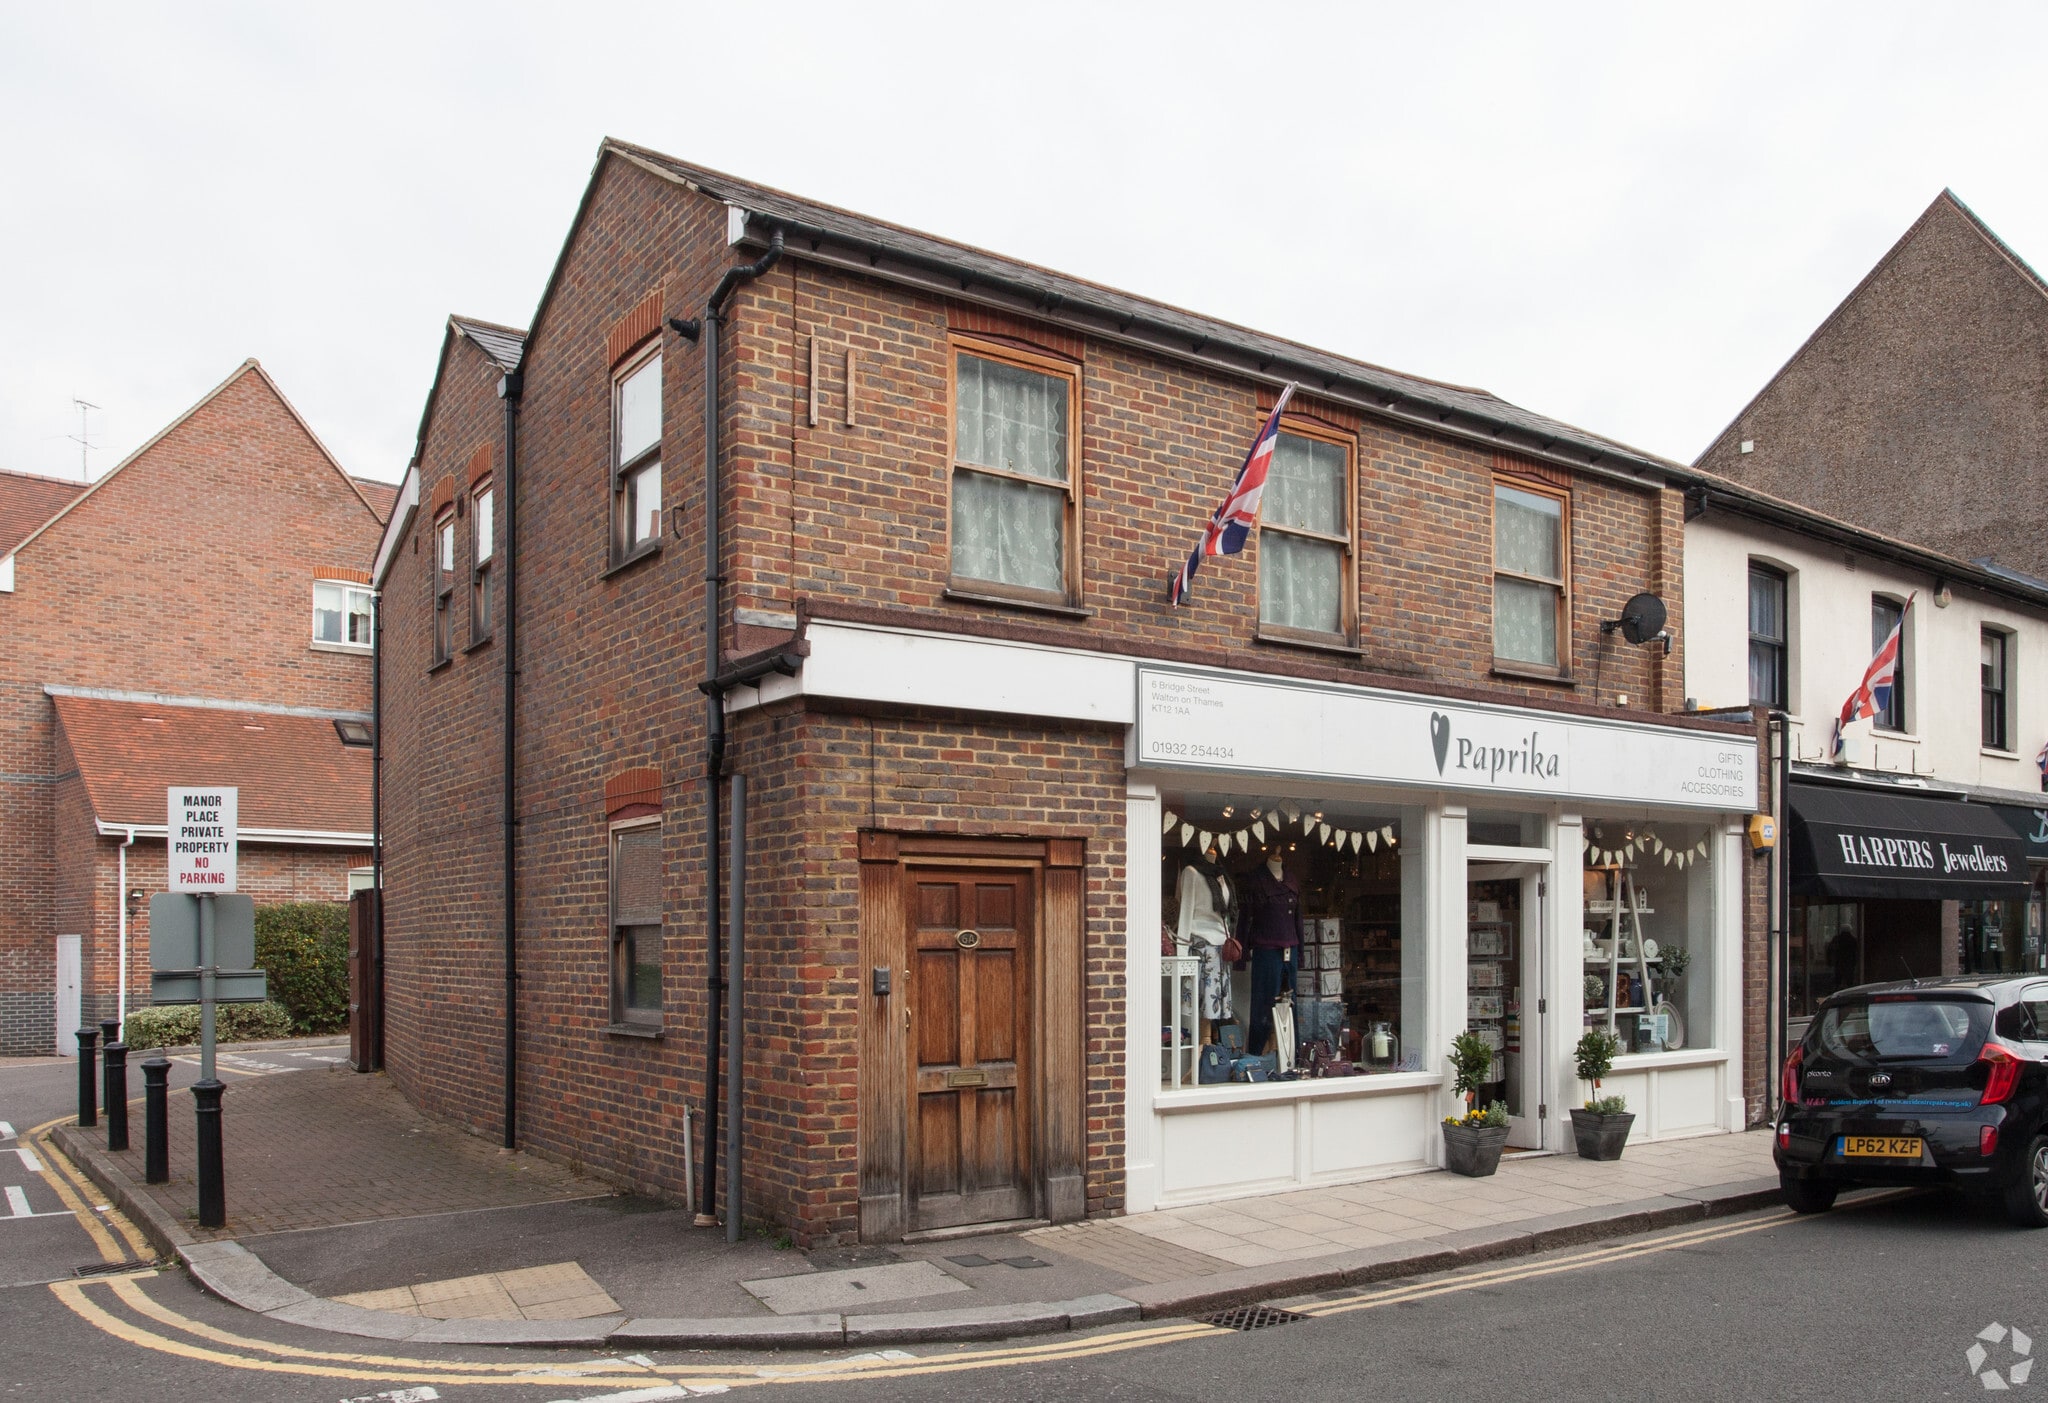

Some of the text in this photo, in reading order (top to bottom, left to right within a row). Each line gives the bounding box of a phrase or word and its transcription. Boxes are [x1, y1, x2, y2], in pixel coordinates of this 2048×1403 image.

[1151, 681, 1210, 694] 6 Bridge Street
[1151, 692, 1179, 702] Walton
[1193, 697, 1224, 708] Thames
[1151, 704, 1190, 715] KT12 1AA
[1152, 741, 1234, 758] 01932 254434
[1456, 731, 1560, 784] Paprika
[1718, 752, 1743, 765] GIFTS
[1698, 766, 1743, 781] CLOTHING
[1681, 781, 1744, 797] ACCESSORIES
[183, 795, 222, 807] MANOR
[186, 811, 219, 822] PLACE
[181, 826, 224, 838] PRIVATE
[175, 842, 229, 853] PROPERTY
[1838, 833, 2008, 874] HARPERS Jewellers
[195, 857, 209, 868] NO
[180, 872, 225, 884] PARKING
[961, 934, 975, 944] 6A
[1872, 1076, 1887, 1084] KIA
[1846, 1138, 1920, 1154] LP62 KZF
